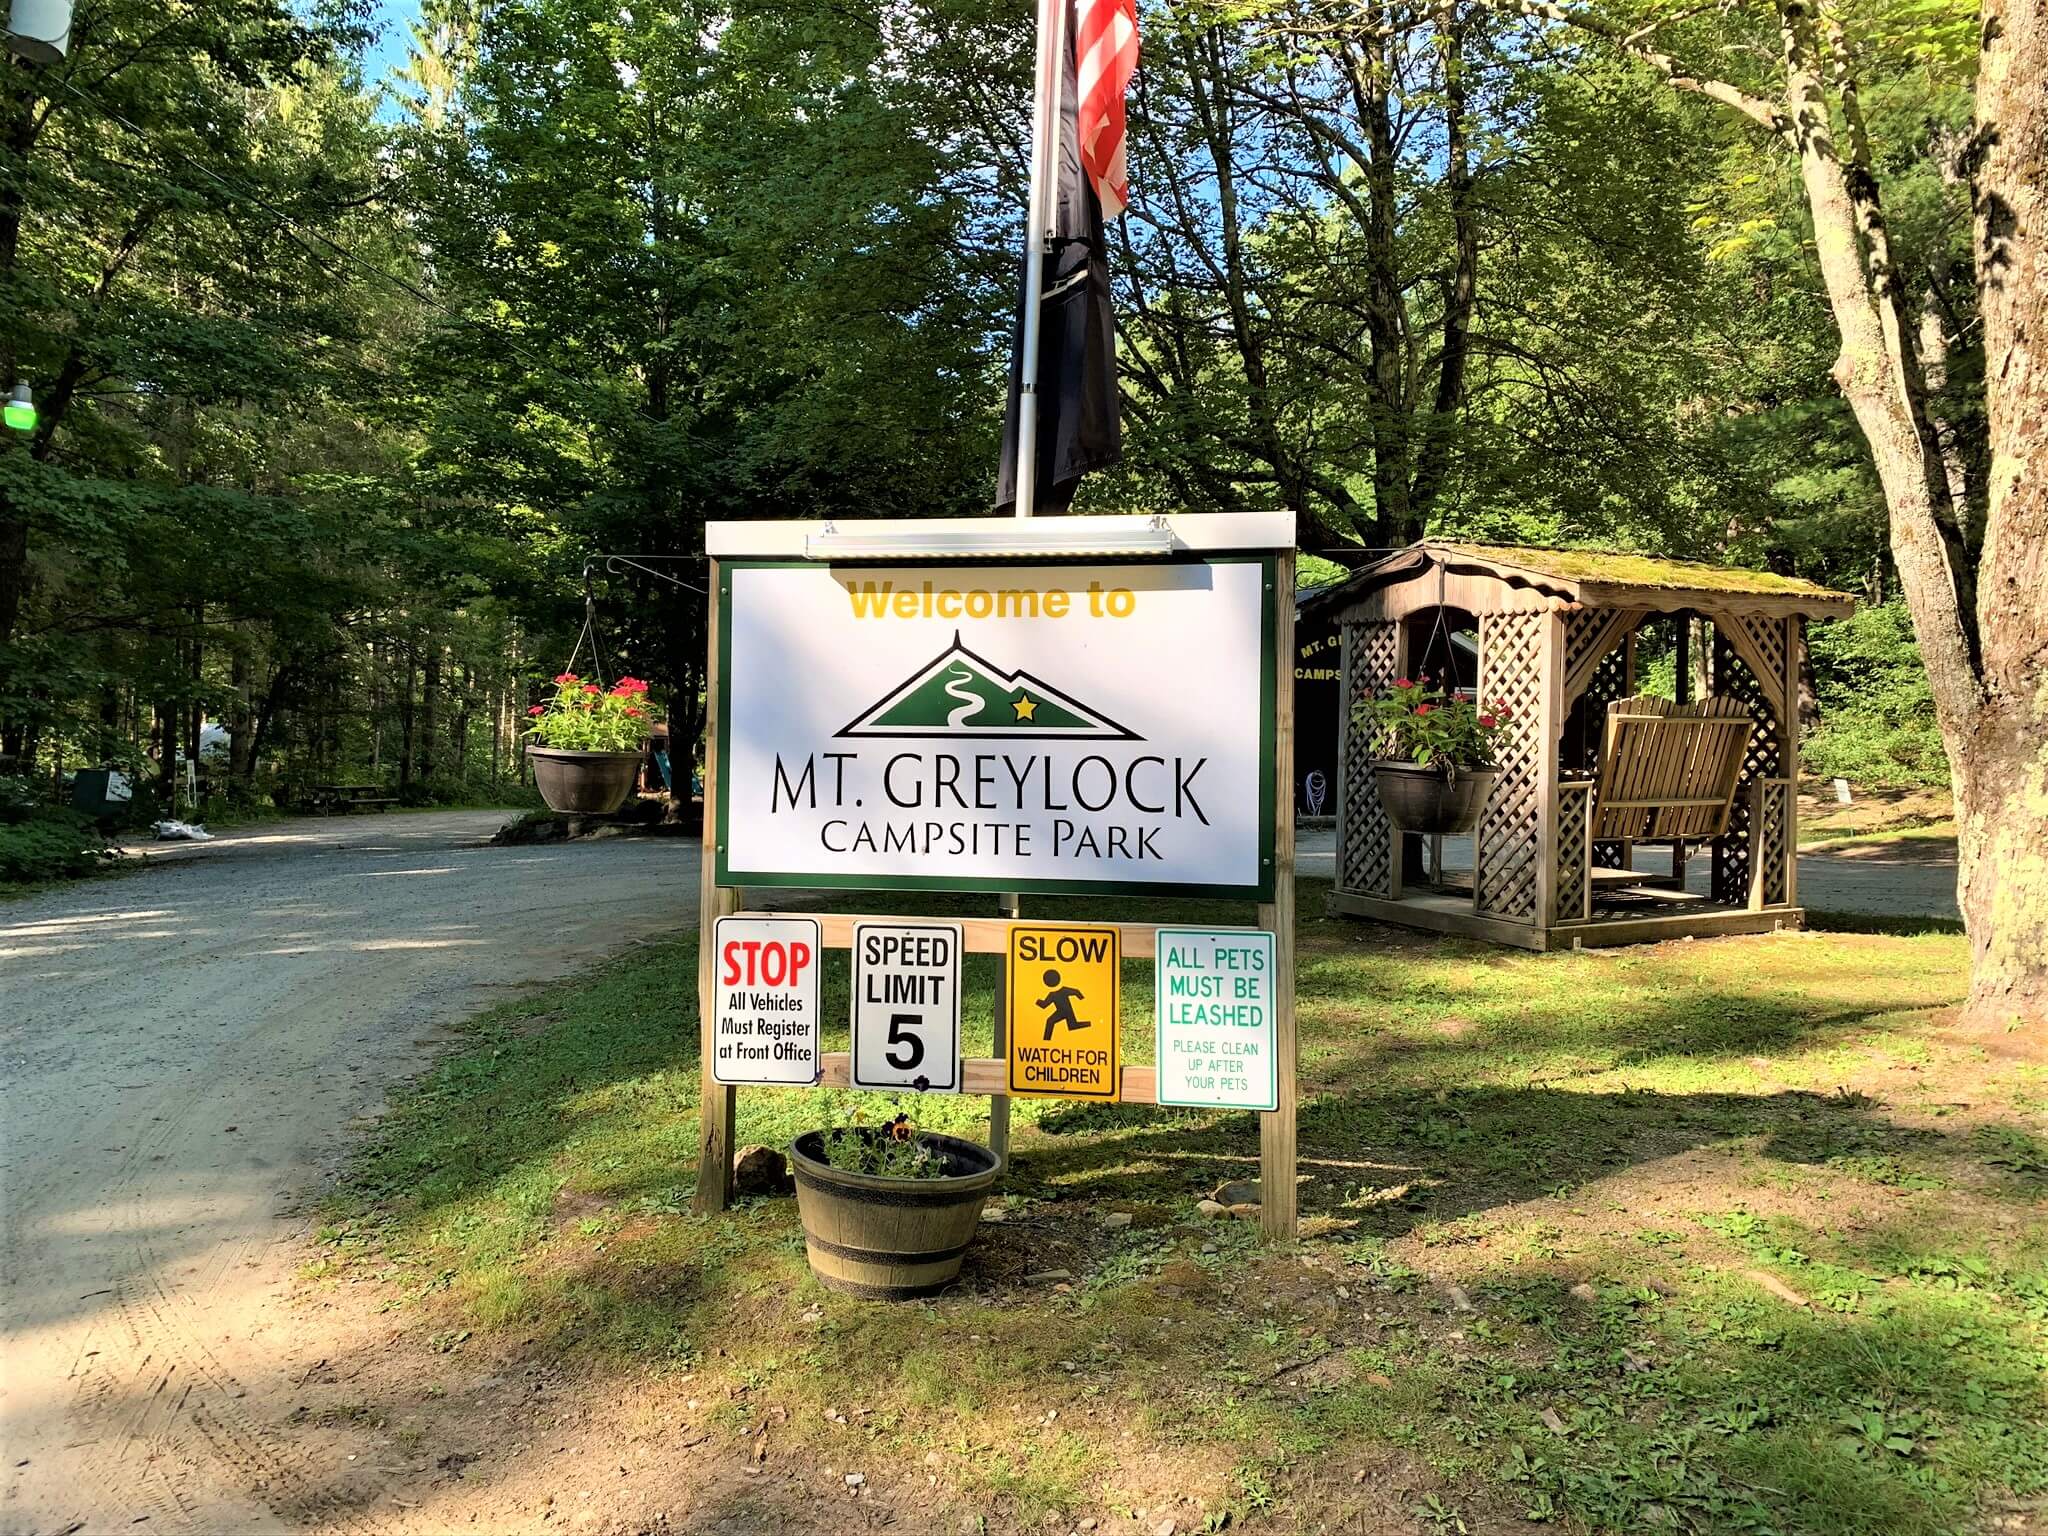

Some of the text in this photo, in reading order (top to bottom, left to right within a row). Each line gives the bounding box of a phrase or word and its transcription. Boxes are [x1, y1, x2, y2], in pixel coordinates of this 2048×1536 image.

[847, 580, 1136, 619] Welcome to
[1301, 640, 1324, 658] MT.
[771, 752, 1210, 825] MT. GREYLOCK
[821, 819, 1164, 860] CAMPSITE PARK
[865, 935, 948, 967] SPEED
[1019, 936, 1108, 963] SLOW
[1167, 947, 1264, 971] ALL PETS
[723, 941, 810, 987] STOP
[867, 974, 944, 1005] LIMIT
[1170, 976, 1260, 999] MUST BE
[729, 992, 803, 1012] All Vehicles
[1169, 1004, 1263, 1027] LEASHED
[722, 1018, 810, 1040] Must Register
[719, 1042, 812, 1061] at Front Office
[886, 1013, 924, 1070] 5
[1174, 1040, 1259, 1055] PLEASE CLEAN
[1018, 1047, 1108, 1066] WATCH FOR
[1188, 1058, 1244, 1072] UP AFTER
[1025, 1066, 1100, 1084] CHILDREN
[1185, 1075, 1248, 1091] YOUR PETS
